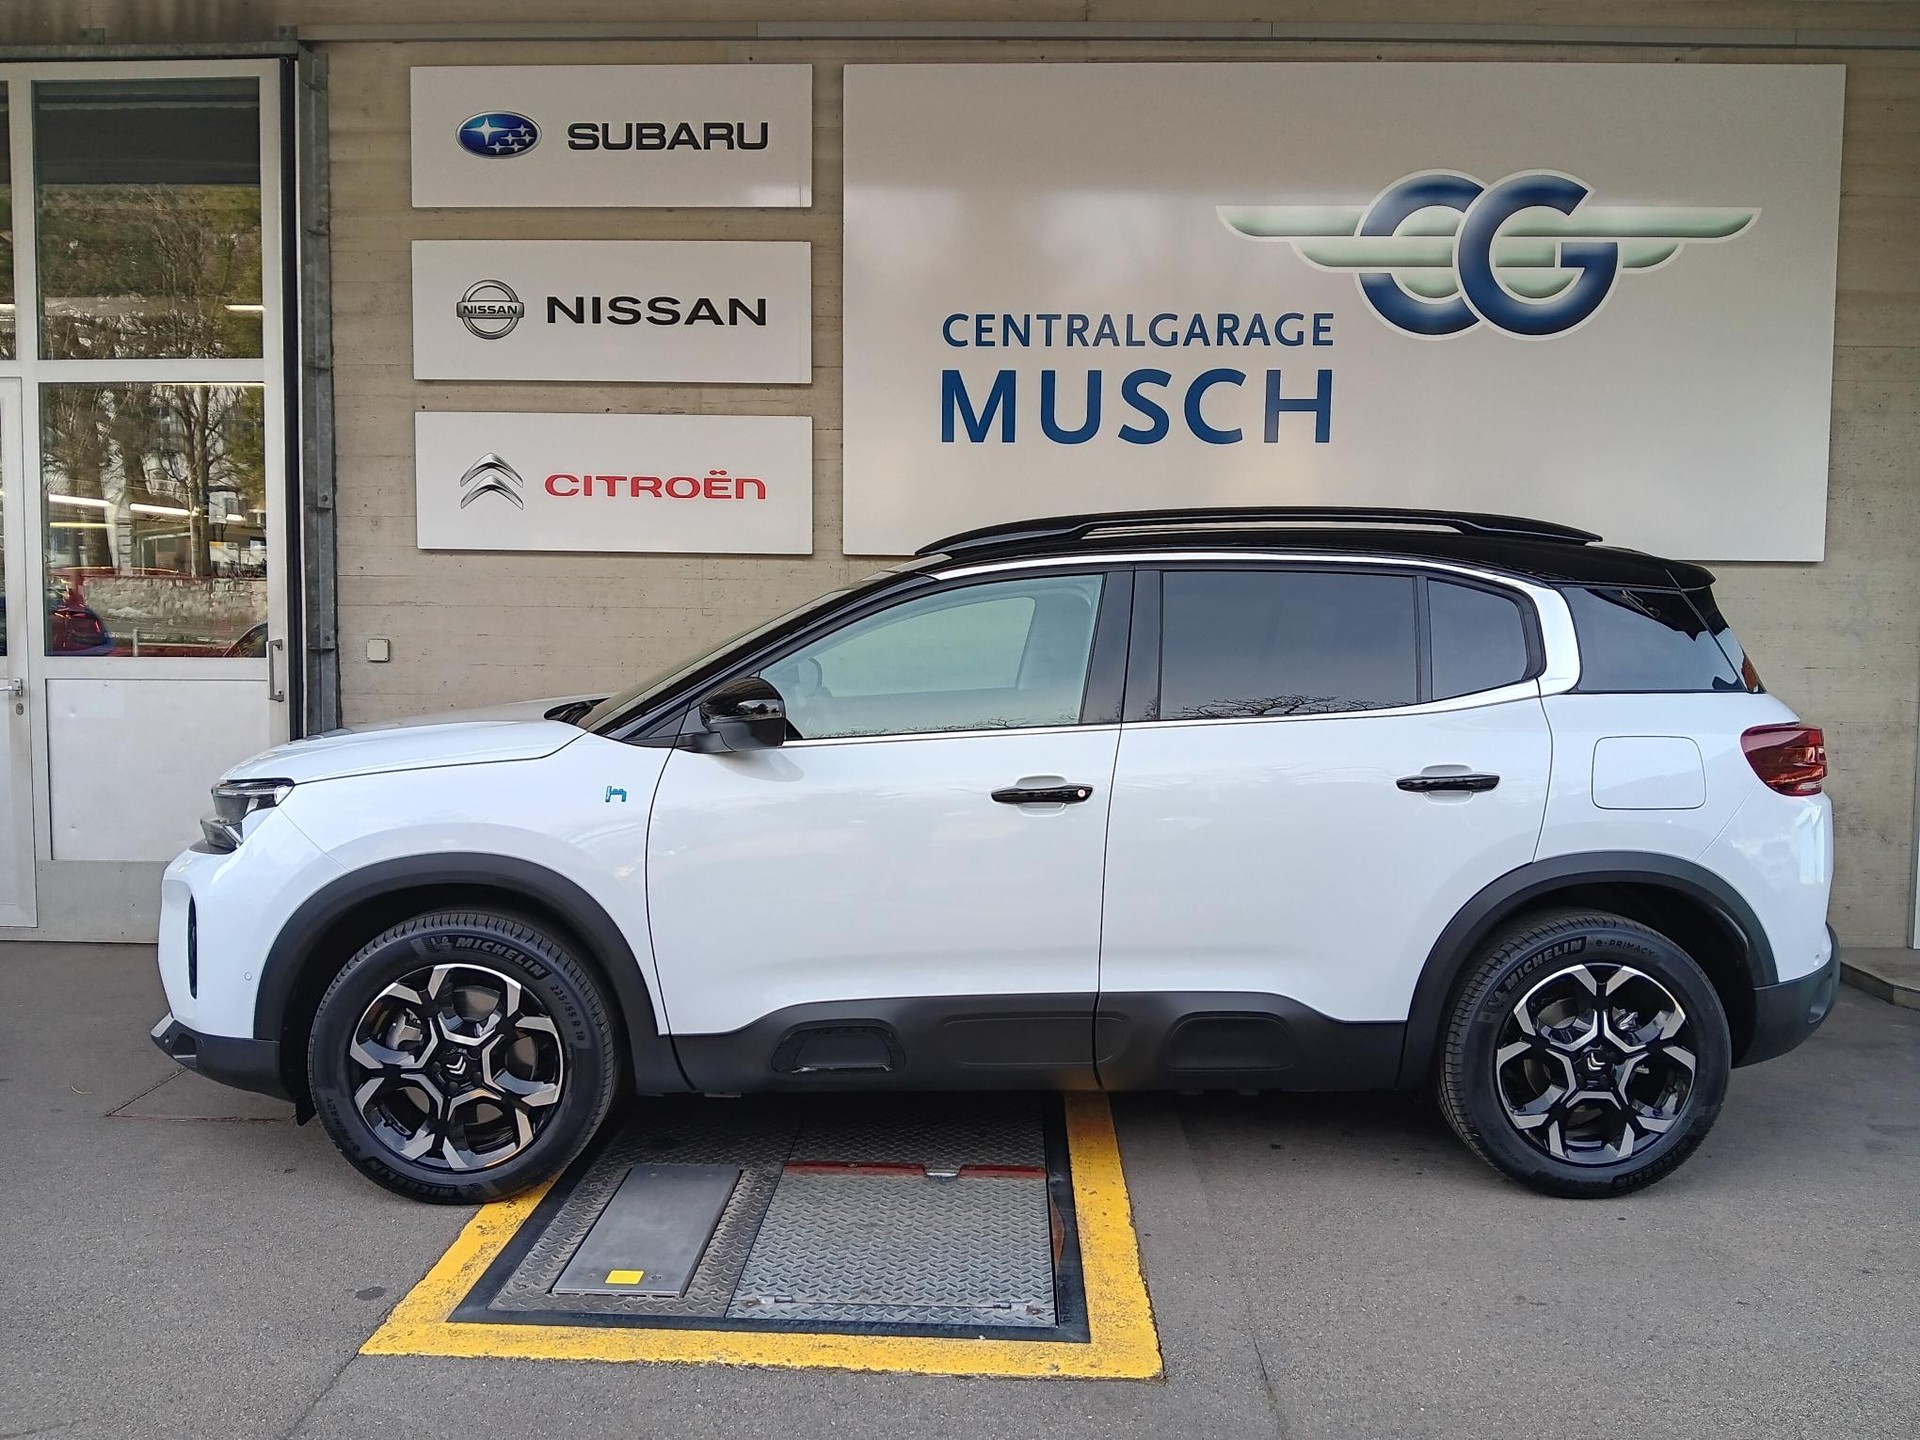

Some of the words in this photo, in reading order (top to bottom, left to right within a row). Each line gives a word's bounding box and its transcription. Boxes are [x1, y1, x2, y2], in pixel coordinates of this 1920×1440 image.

[567, 122, 769, 150] SUBARU
[463, 304, 518, 316] NISSAN
[547, 296, 766, 326] NISSAN
[941, 312, 1334, 348] CENTRALGARAGE
[941, 368, 1333, 445] MUSCH
[455, 937, 547, 977] MICHELIN
[1504, 939, 1582, 991] MICHELIN
[550, 984, 577, 1018] 225/55
[571, 1020, 581, 1028] R
[575, 1031, 586, 1041] 18
